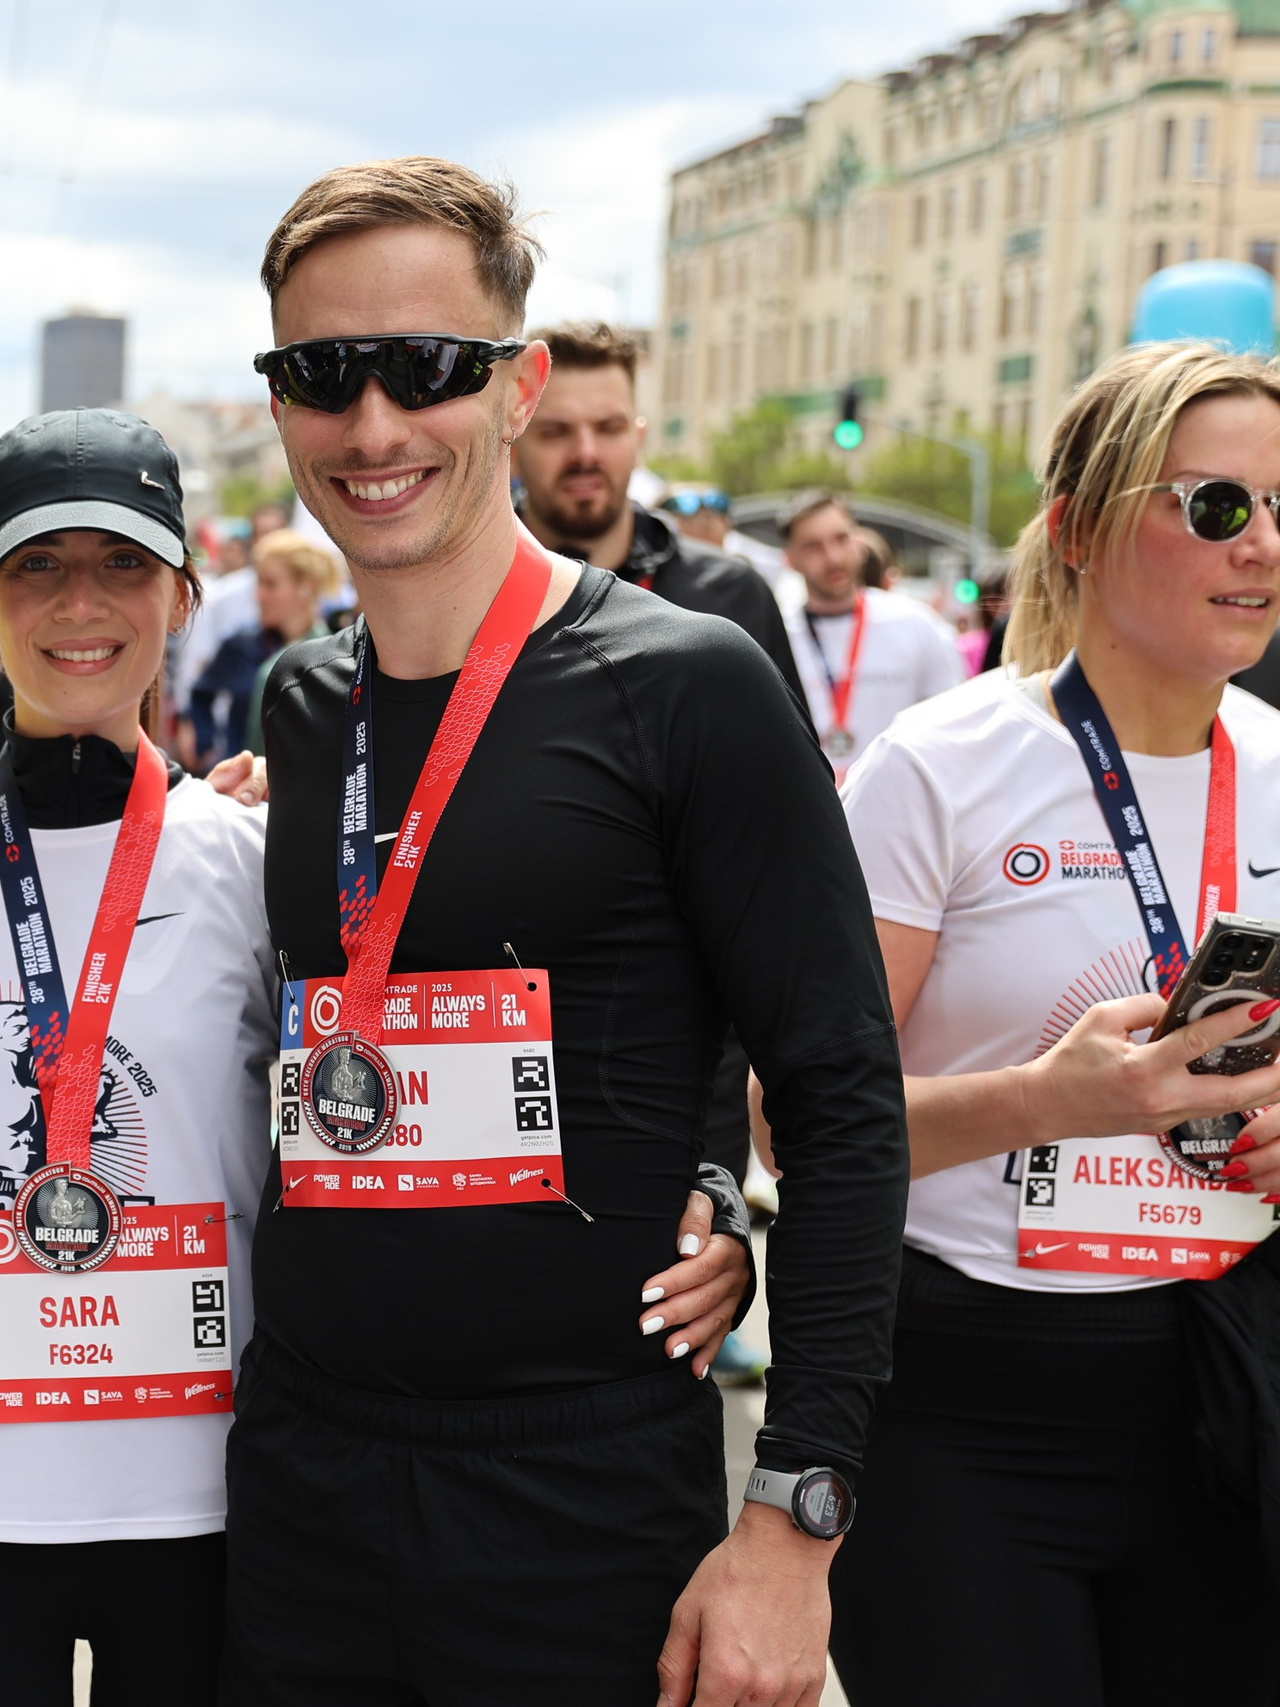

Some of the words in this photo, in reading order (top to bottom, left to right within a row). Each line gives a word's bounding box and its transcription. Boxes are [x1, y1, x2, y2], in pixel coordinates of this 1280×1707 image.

[356, 721, 366, 755] 2025
[1081, 719, 1112, 770] COMTRADE
[344, 772, 357, 835] BELGRADE
[355, 762, 367, 832] MARATHON
[1122, 805, 1144, 837] 2025
[393, 810, 423, 868] FINISHER
[1077, 842, 1112, 850] COMTR
[344, 839, 356, 866] 38TH
[404, 845, 421, 869] 21K
[1061, 852, 1120, 866] BELGRAD
[1062, 867, 1127, 880] MARATHO
[1125, 850, 1155, 906] BELGRADE
[1135, 842, 1167, 905] MARATHON
[20, 876, 38, 907] 2025
[16, 921, 39, 977] BELGRADE
[28, 912, 53, 974] MARATHON
[81, 952, 107, 1004] FINISHER
[28, 981, 45, 1004] 38TH
[96, 982, 114, 1004] 21K
[431, 995, 486, 1012] ALWAYS
[501, 994, 517, 1009] 21
[288, 1004, 299, 1036] C
[431, 983, 452, 993] 2025
[431, 1012, 469, 1029] MORE
[502, 1010, 527, 1026] KM
[321, 1035, 349, 1051] MARATHON
[127, 1062, 158, 1097] 2025
[383, 1070, 395, 1093] ALWAYS
[319, 1099, 376, 1123] BELGRADE
[337, 1127, 353, 1140] 21K
[314, 1174, 340, 1182] POWER
[416, 1177, 439, 1185] SAVA
[509, 1168, 544, 1187] Wellness
[1138, 1202, 1202, 1225] F5679
[35, 1227, 99, 1243] BELGRADE
[183, 1225, 197, 1240] 21
[58, 1250, 75, 1261] 21K
[117, 1242, 154, 1258] MORE
[184, 1239, 205, 1255] KM
[39, 1295, 120, 1329] SARA
[49, 1343, 113, 1366] F6324
[101, 1391, 123, 1399] SAVA
[185, 1383, 216, 1400] Wellness
[825, 1495, 836, 1517] 6:23
